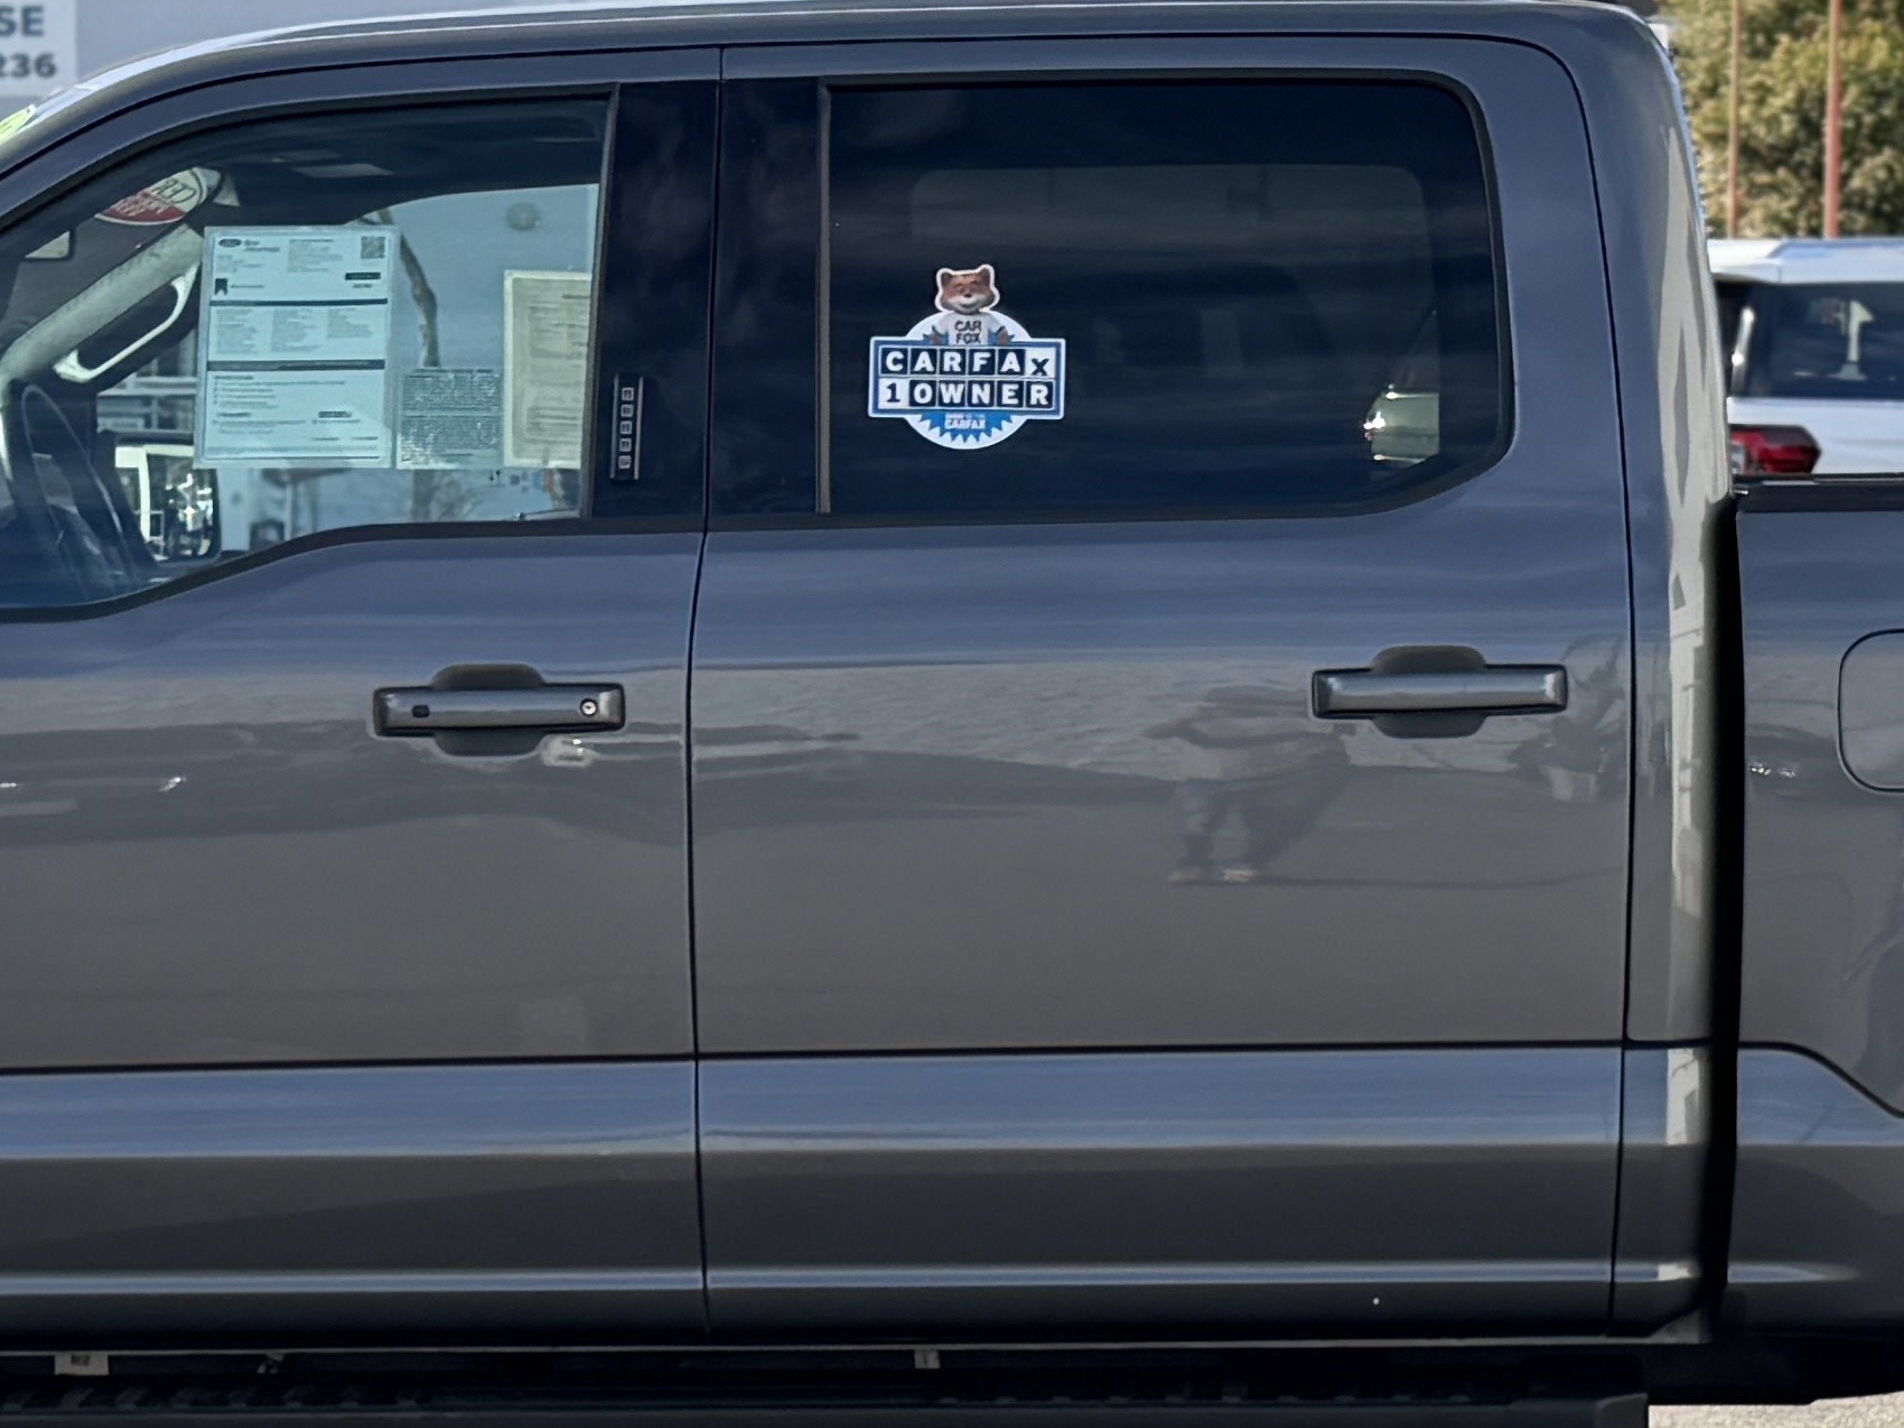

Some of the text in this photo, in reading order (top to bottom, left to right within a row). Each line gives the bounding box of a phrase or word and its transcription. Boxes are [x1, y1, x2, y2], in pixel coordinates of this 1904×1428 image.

[955, 320, 982, 332] CAR
[956, 333, 982, 344] FOX
[885, 351, 1050, 377] CARFAX
[885, 382, 1049, 406] 1 OWNER
